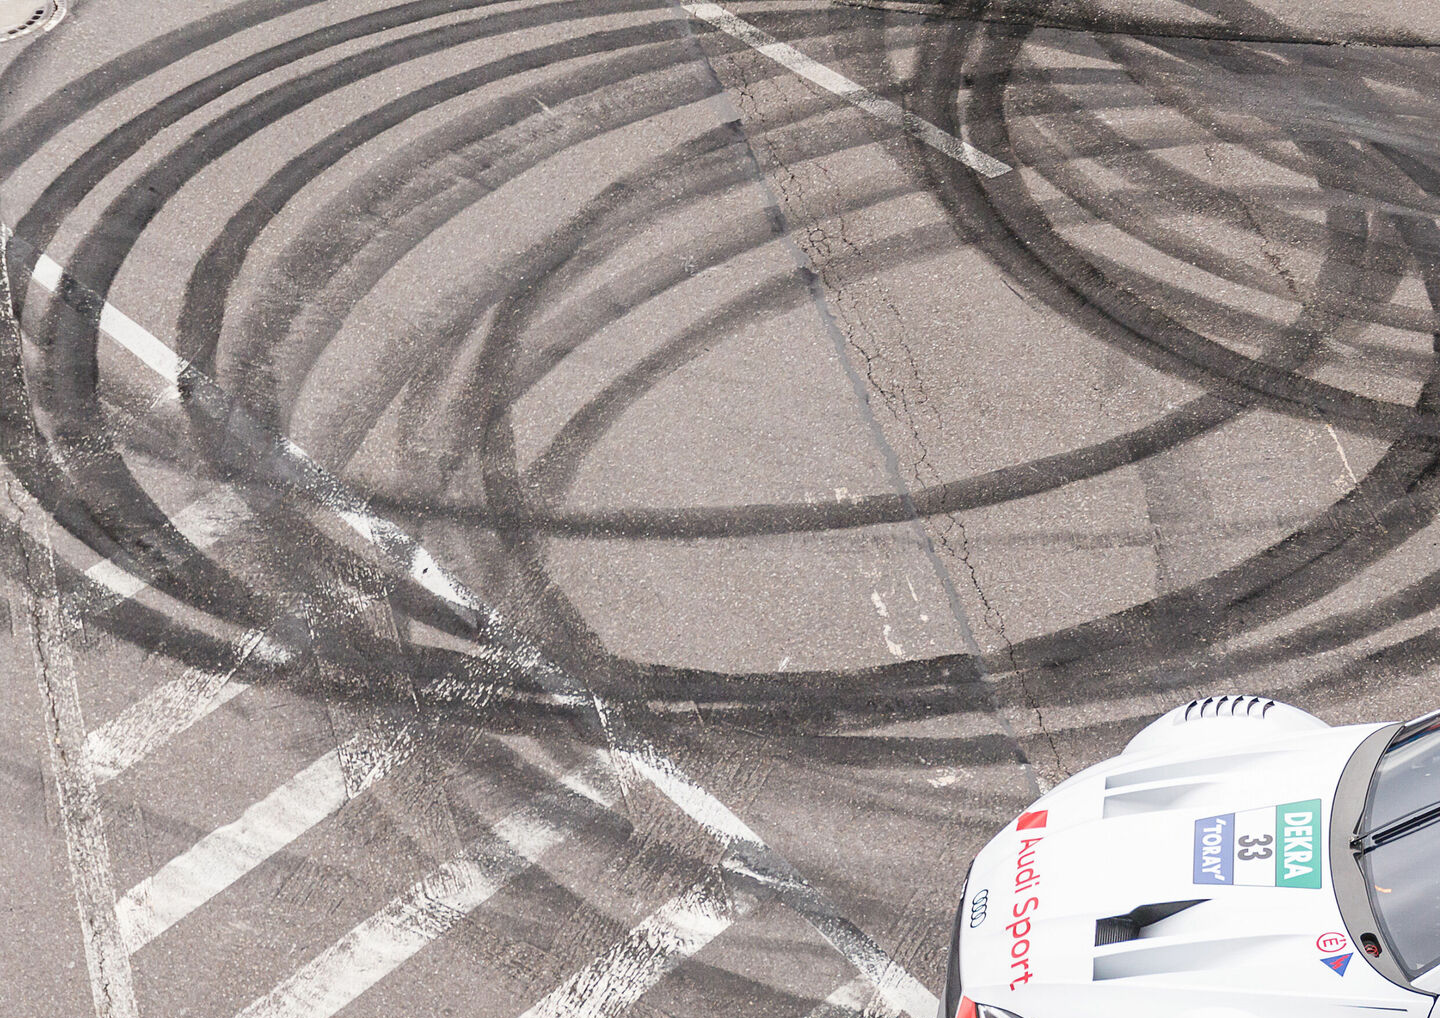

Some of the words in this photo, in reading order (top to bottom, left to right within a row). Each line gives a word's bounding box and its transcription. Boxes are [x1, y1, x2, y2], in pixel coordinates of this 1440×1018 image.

[1011, 837, 1044, 894] Audi
[1237, 834, 1273, 861] 33
[1284, 811, 1313, 880] DEKRA
[1005, 896, 1039, 991] Sport
